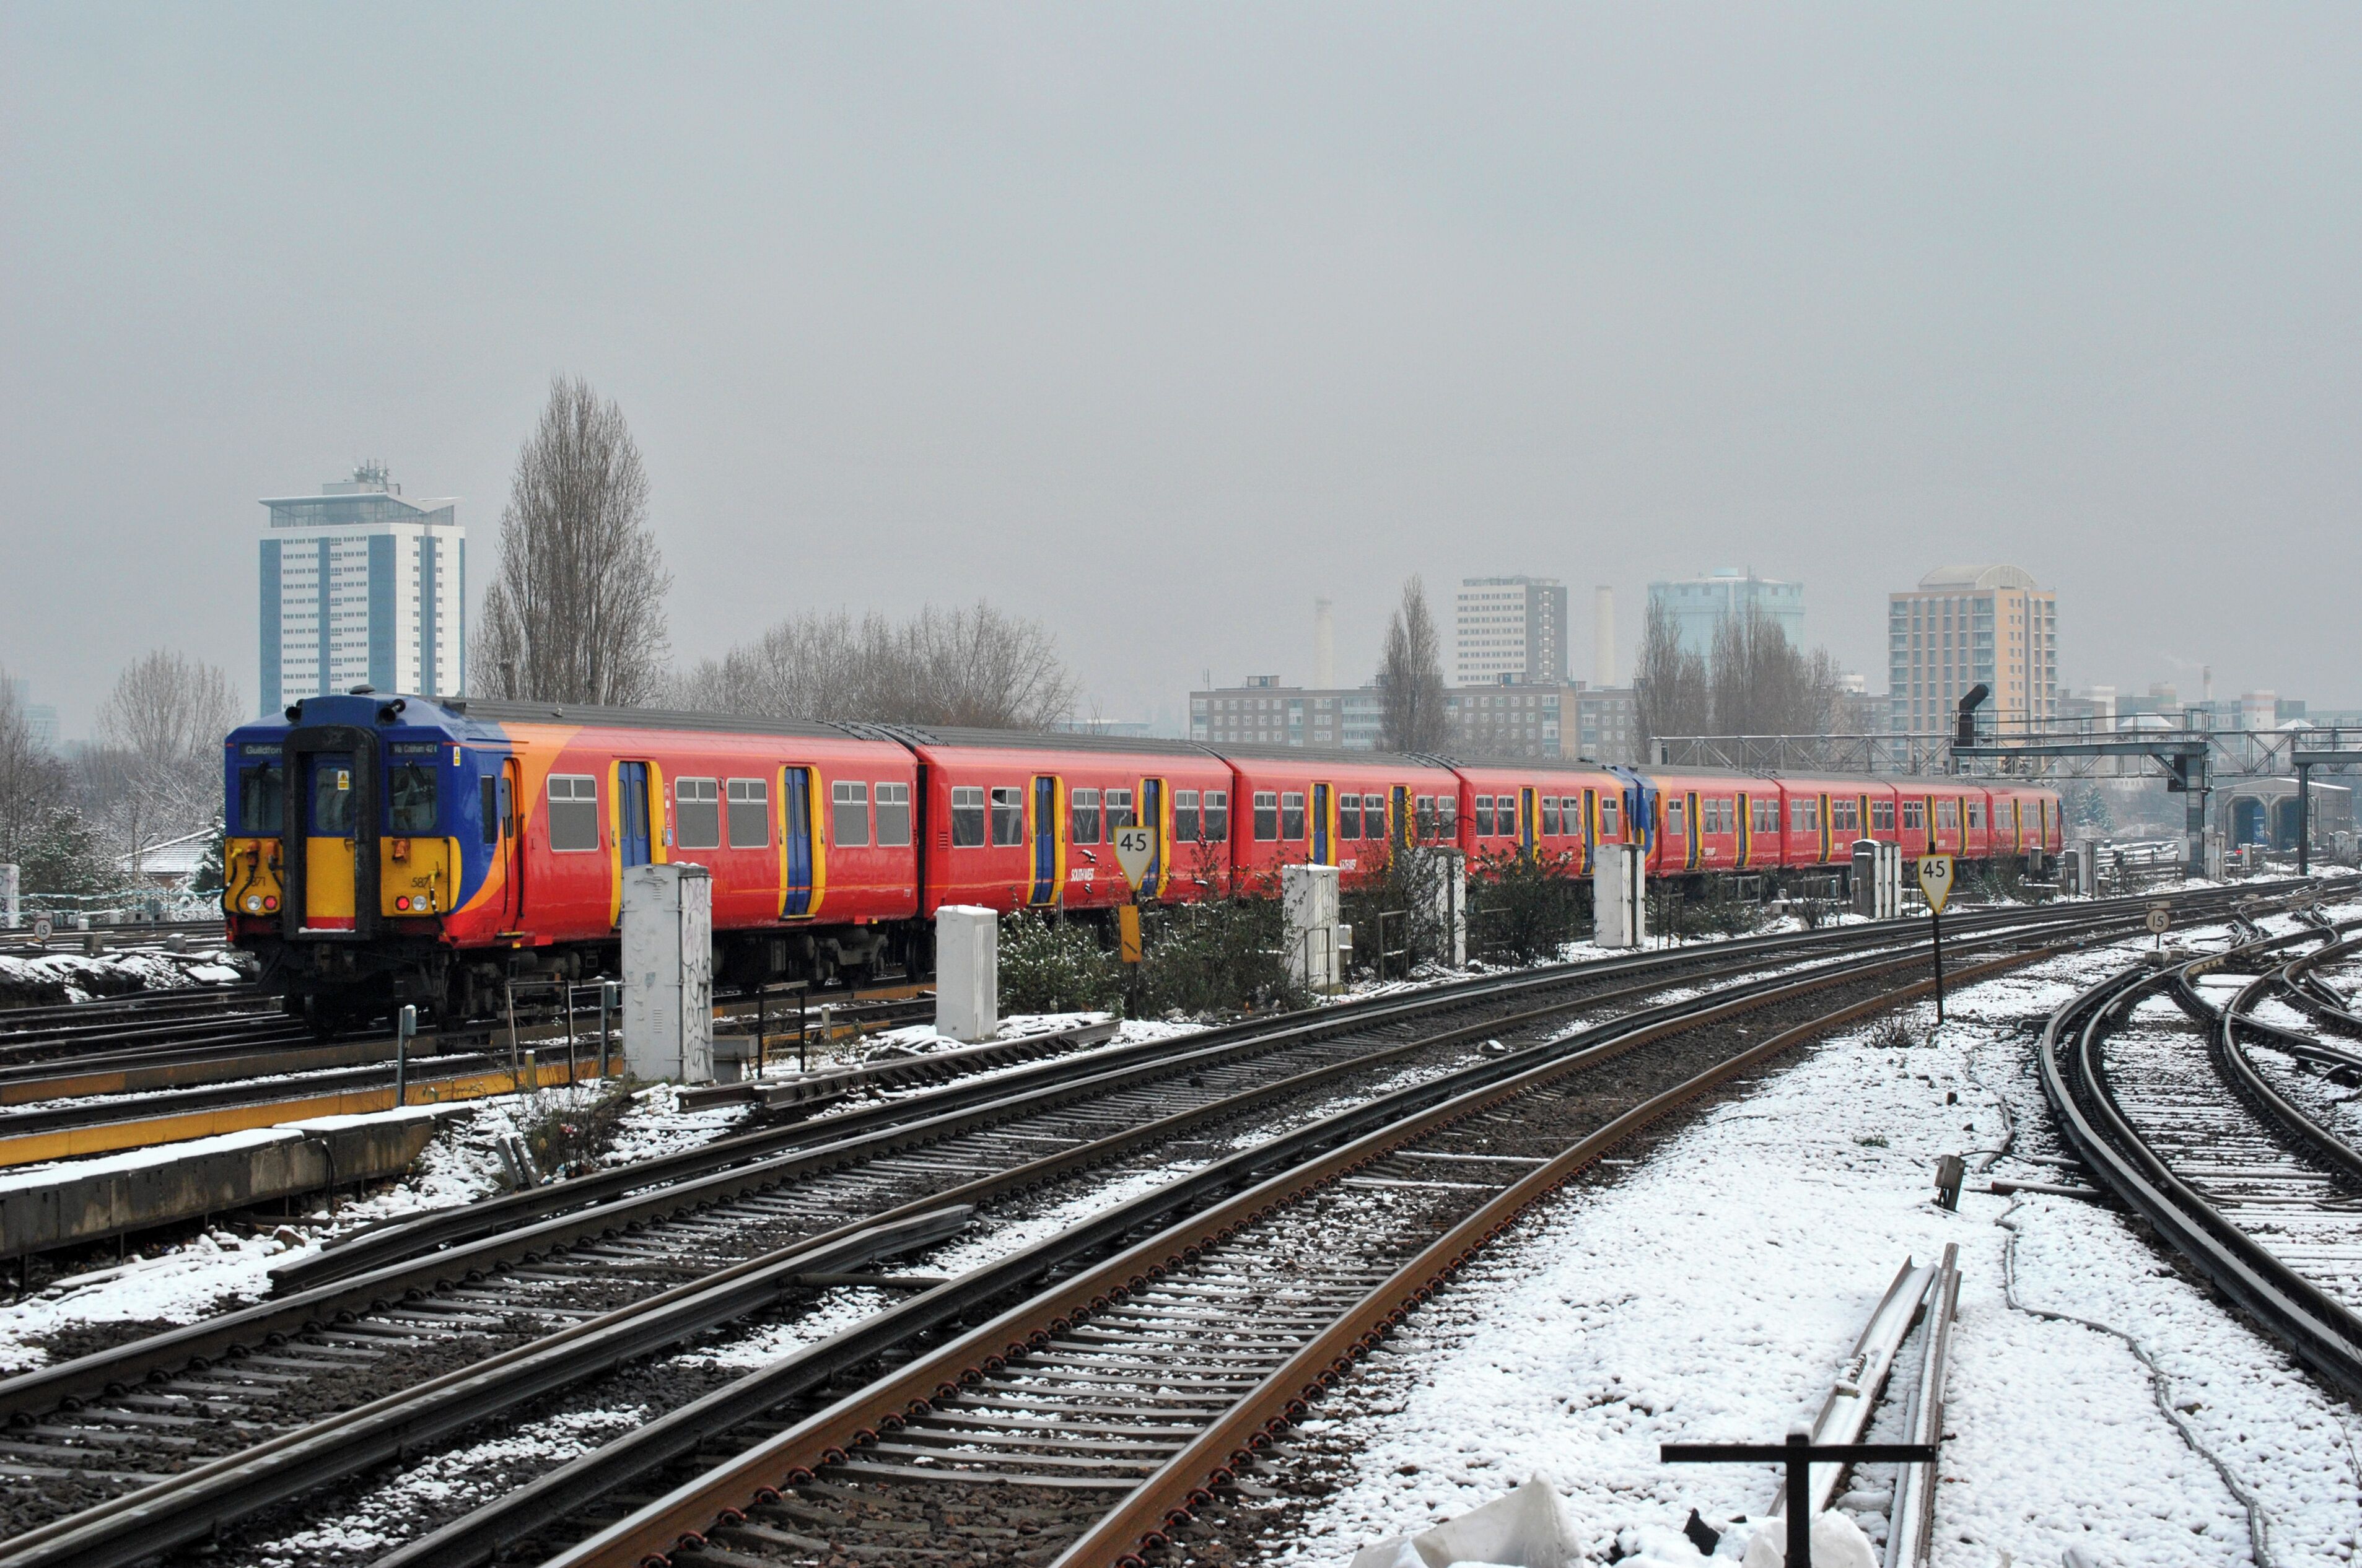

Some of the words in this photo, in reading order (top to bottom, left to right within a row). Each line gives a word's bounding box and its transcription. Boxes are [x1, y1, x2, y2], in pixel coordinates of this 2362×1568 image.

[1120, 833, 1147, 852] 45
[1923, 860, 1945, 878] 45
[411, 877, 429, 887] 587
[2153, 915, 2164, 927] 15
[39, 925, 48, 935] 15
